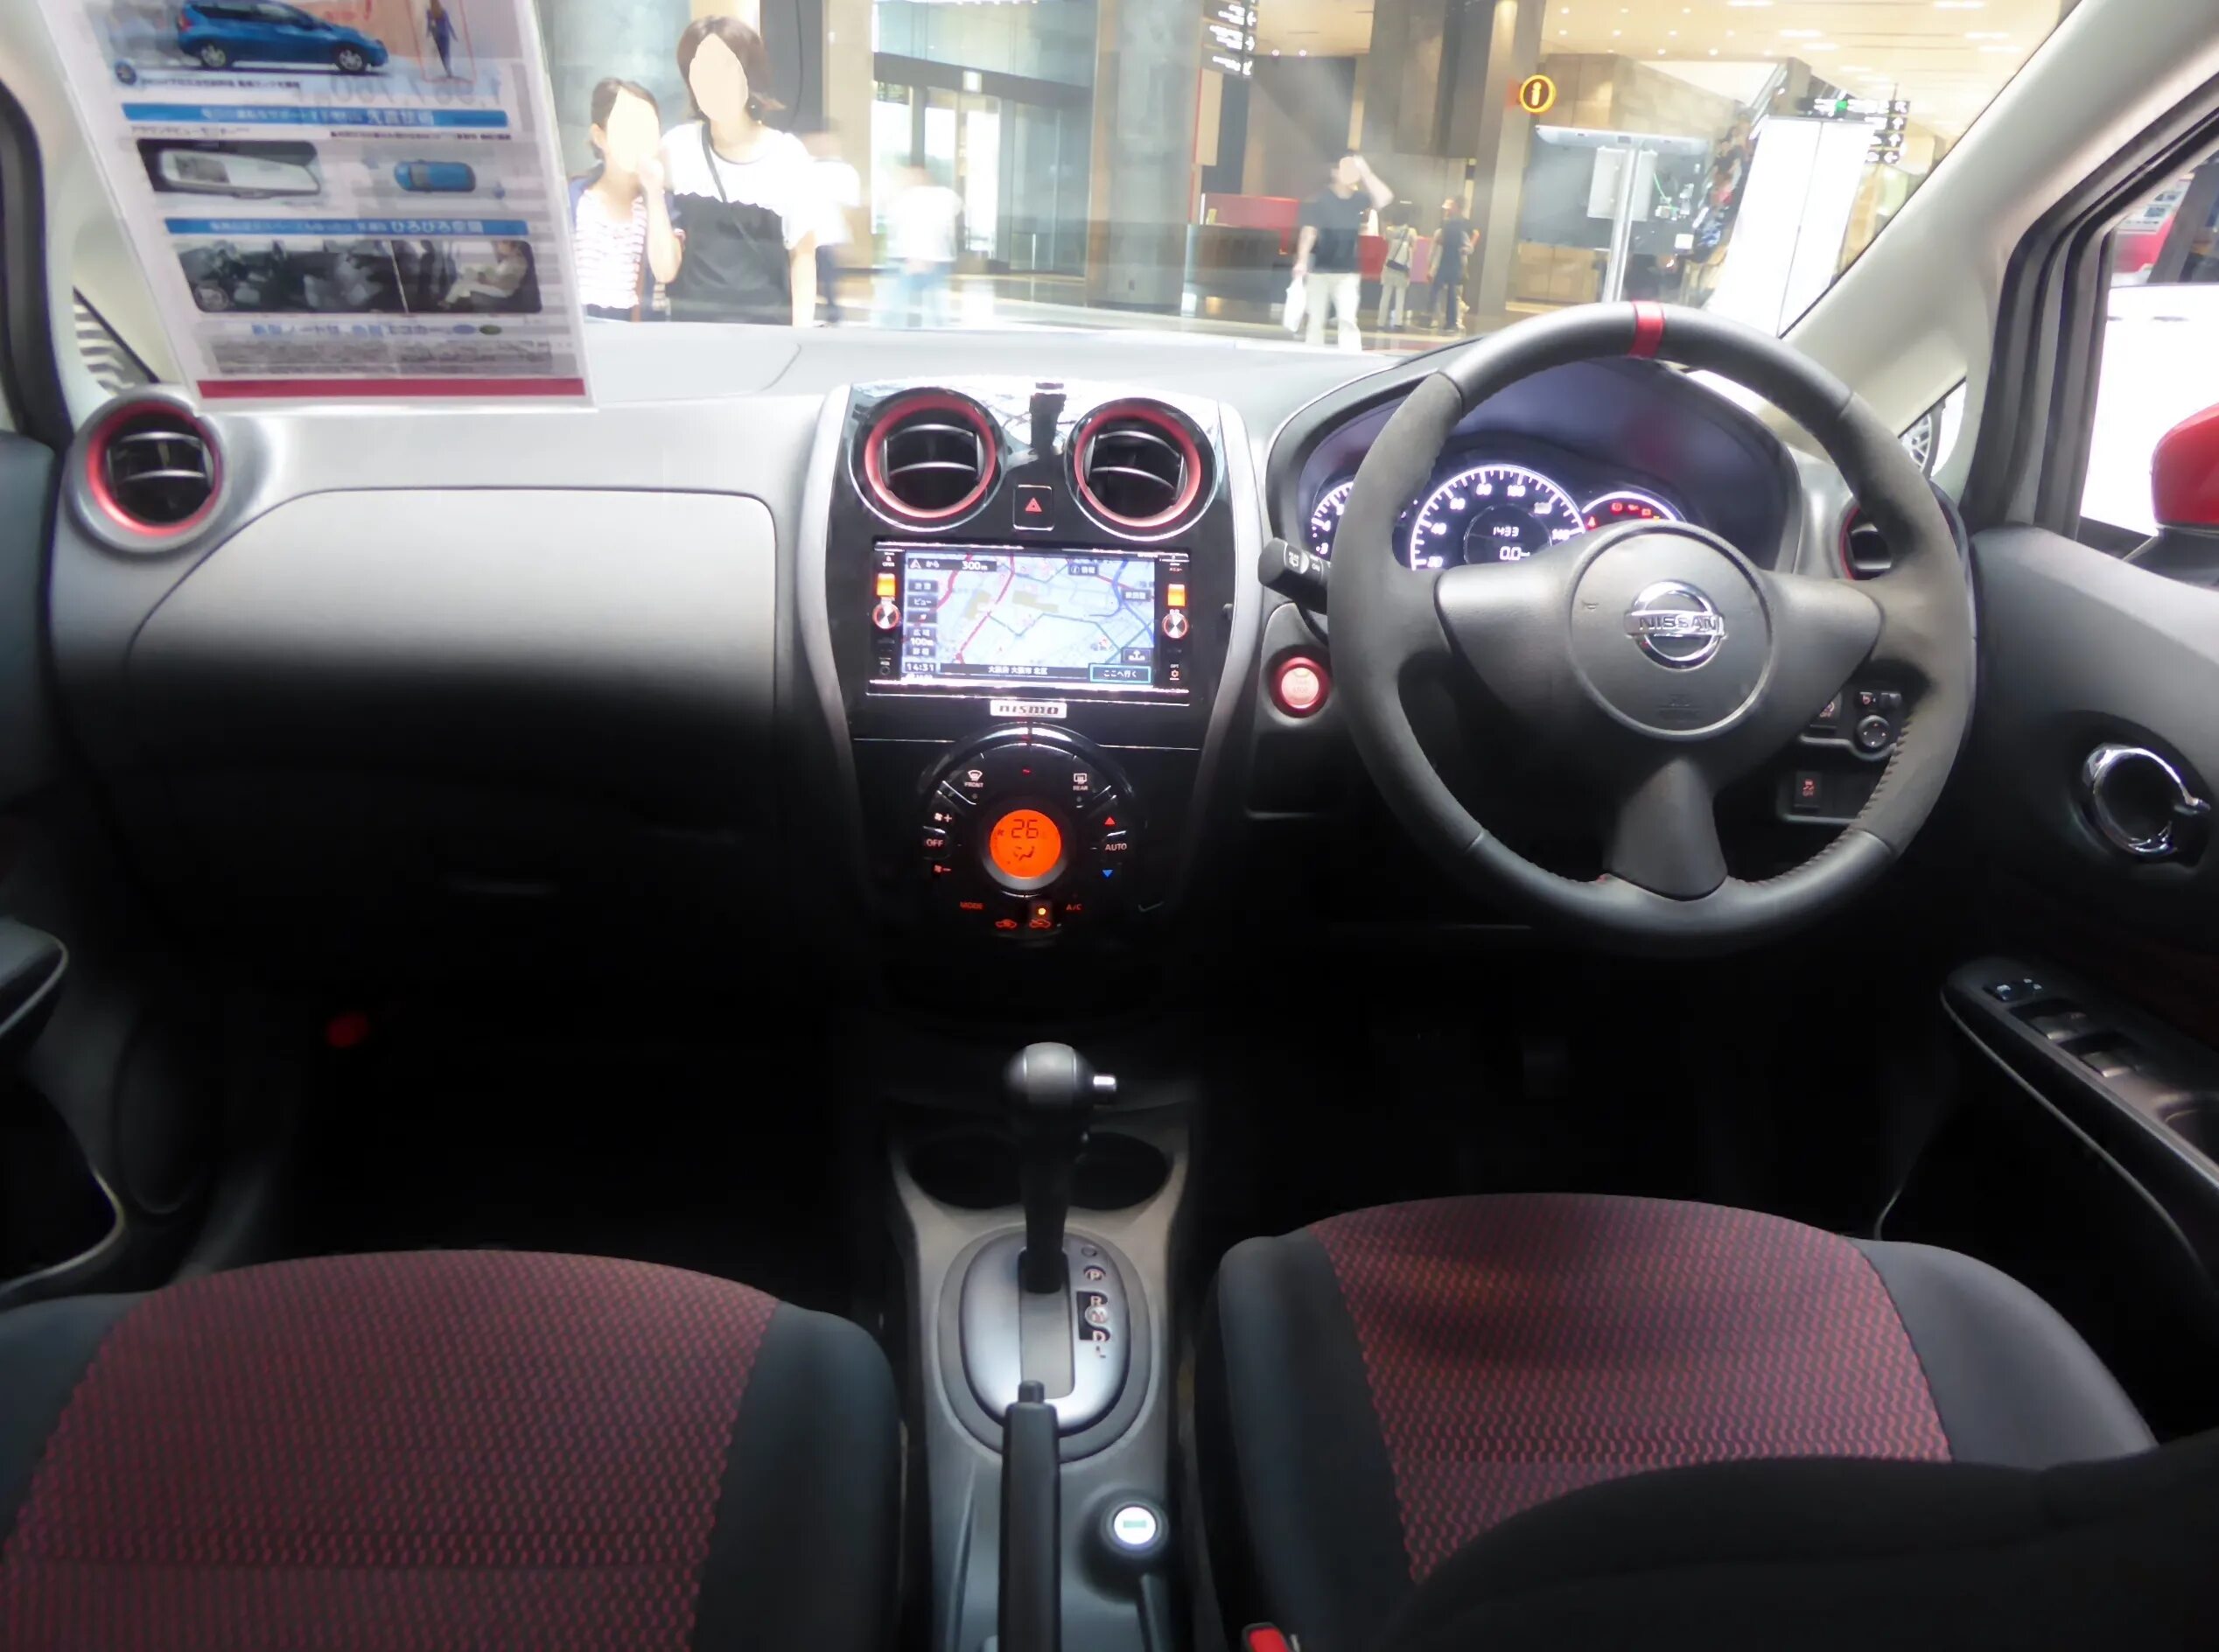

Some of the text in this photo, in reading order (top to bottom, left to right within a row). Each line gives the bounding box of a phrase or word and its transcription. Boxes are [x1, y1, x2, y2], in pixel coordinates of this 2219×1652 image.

[1639, 616, 1717, 632] NISSAN
[1103, 669, 1138, 678] ここへ行く
[1012, 818, 1039, 839] 26
[927, 838, 943, 847] OFF
[1105, 843, 1128, 851] AUTO
[1090, 1271, 1100, 1281] P
[1092, 1330, 1106, 1341] D
